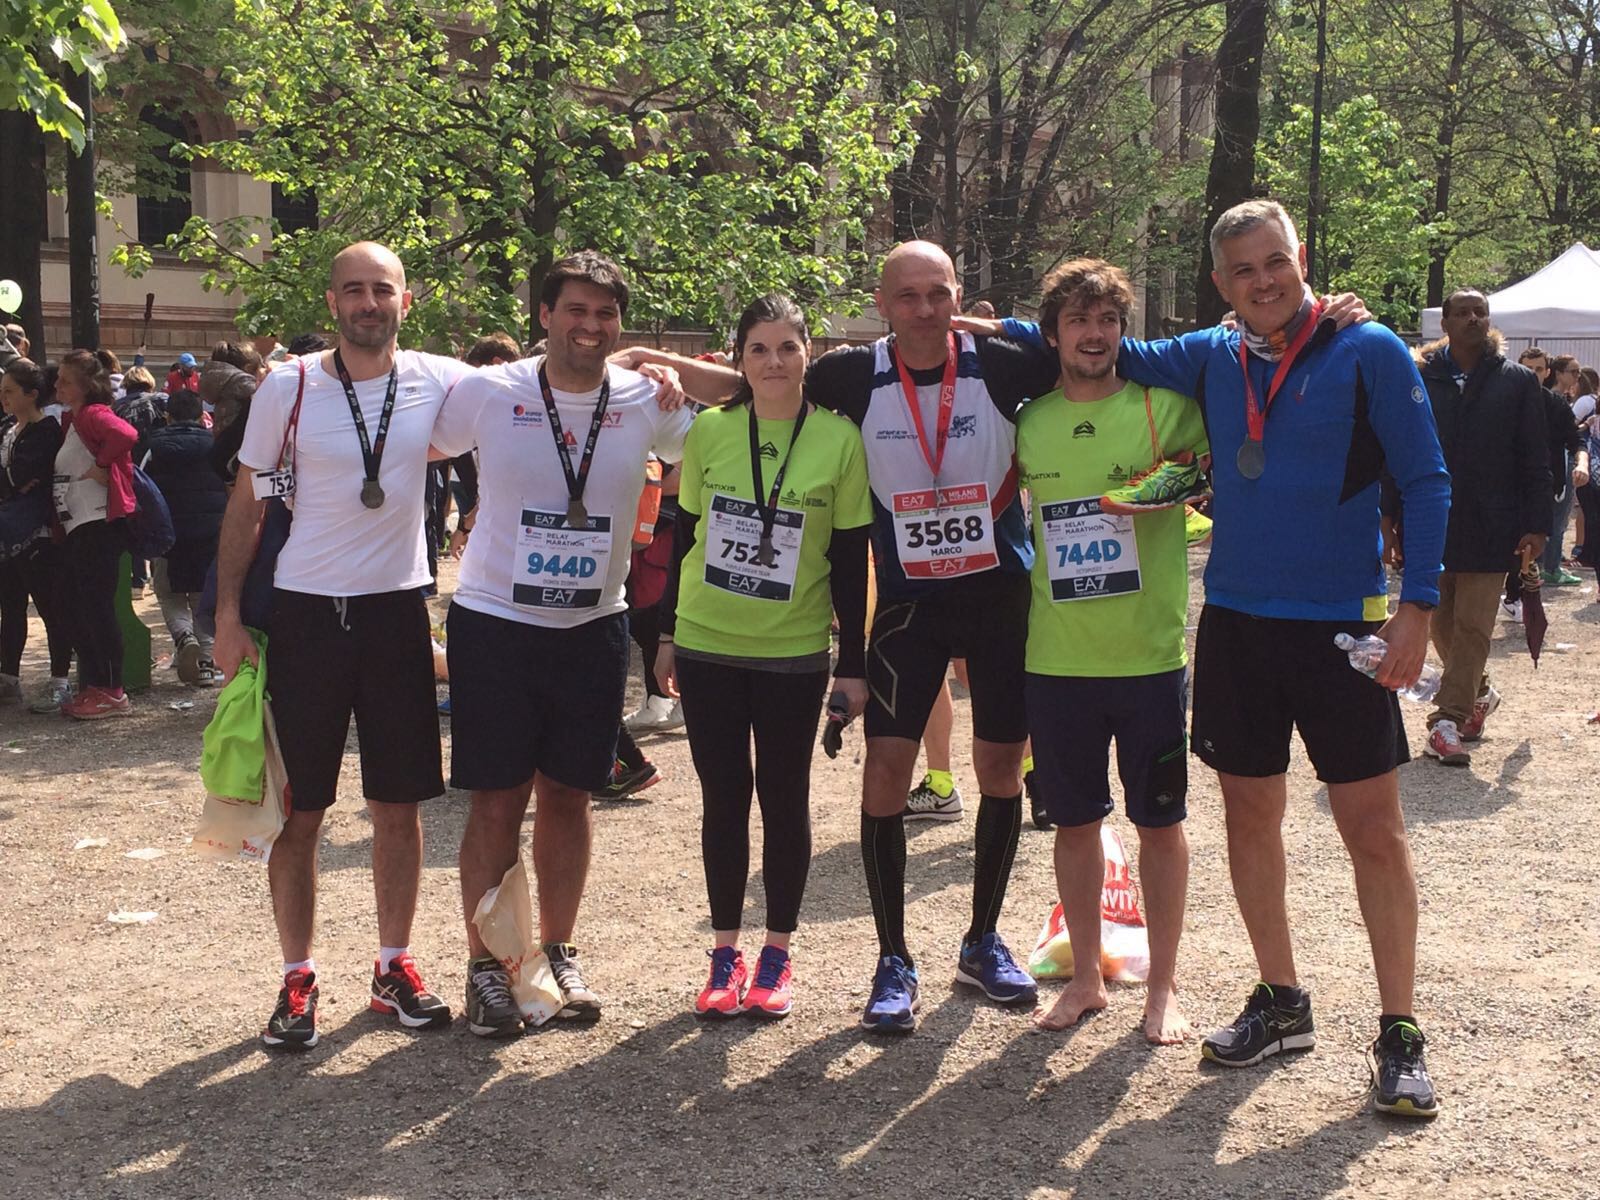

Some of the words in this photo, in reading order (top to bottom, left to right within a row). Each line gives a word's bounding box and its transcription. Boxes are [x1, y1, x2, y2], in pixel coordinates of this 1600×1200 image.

[943, 385, 954, 408] EA7
[948, 488, 978, 499] MILANO
[725, 501, 747, 512] EA7
[902, 495, 926, 507] EA7
[1051, 505, 1069, 516] EA7
[534, 514, 556, 525] EA7
[736, 519, 758, 528] RELAY
[1064, 519, 1086, 528] RELAY
[904, 516, 984, 549] 3568
[1065, 524, 1104, 535] MARATHON
[546, 532, 569, 540] RELAY
[545, 538, 585, 547] MARATHON
[931, 546, 962, 557] MARCO
[1055, 538, 1122, 568] 744D
[527, 552, 597, 578] 944D
[929, 557, 967, 573] EA7
[729, 573, 762, 592] EA7
[1073, 575, 1107, 592] EA7
[542, 588, 577, 604] EA7
